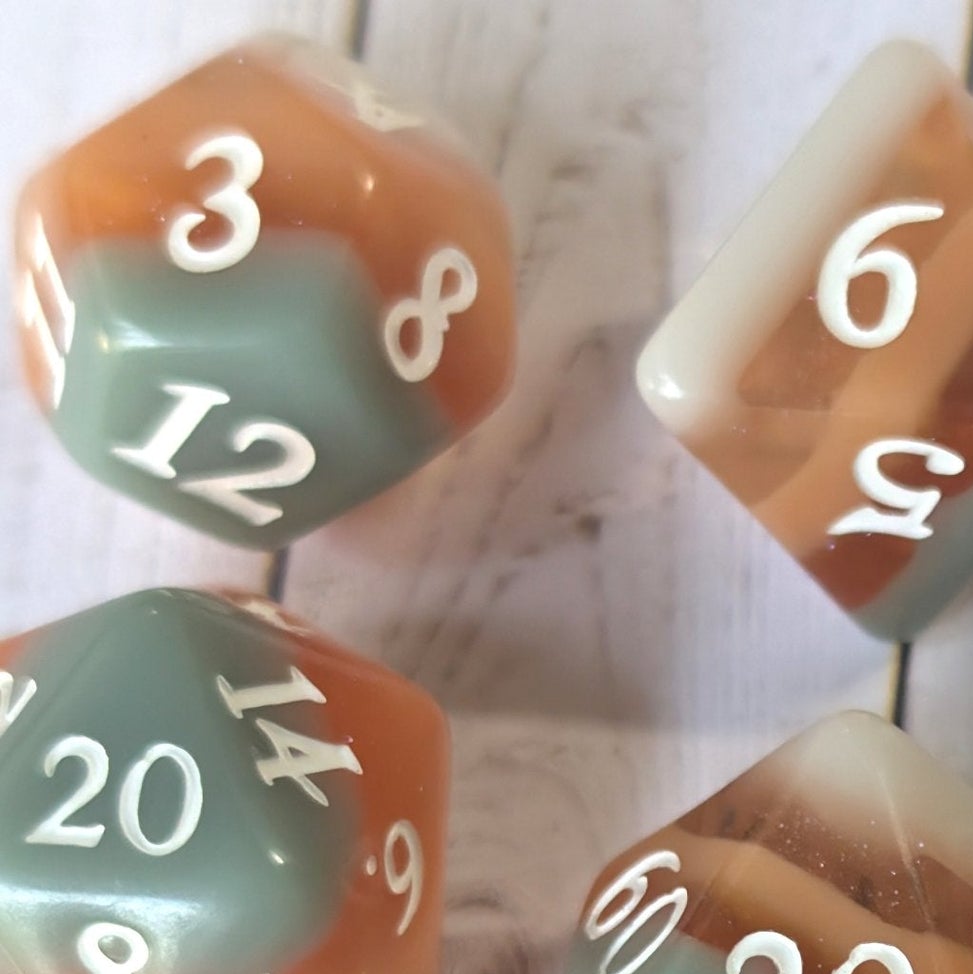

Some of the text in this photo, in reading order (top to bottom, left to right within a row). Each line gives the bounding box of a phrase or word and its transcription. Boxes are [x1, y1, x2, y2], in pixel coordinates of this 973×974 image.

[167, 135, 263, 273] 3
[384, 247, 478, 382] 8
[817, 204, 944, 348] 6
[110, 383, 316, 526] 12
[827, 438, 964, 540] 5
[24, 735, 203, 856] 20
[216, 666, 362, 807] 14
